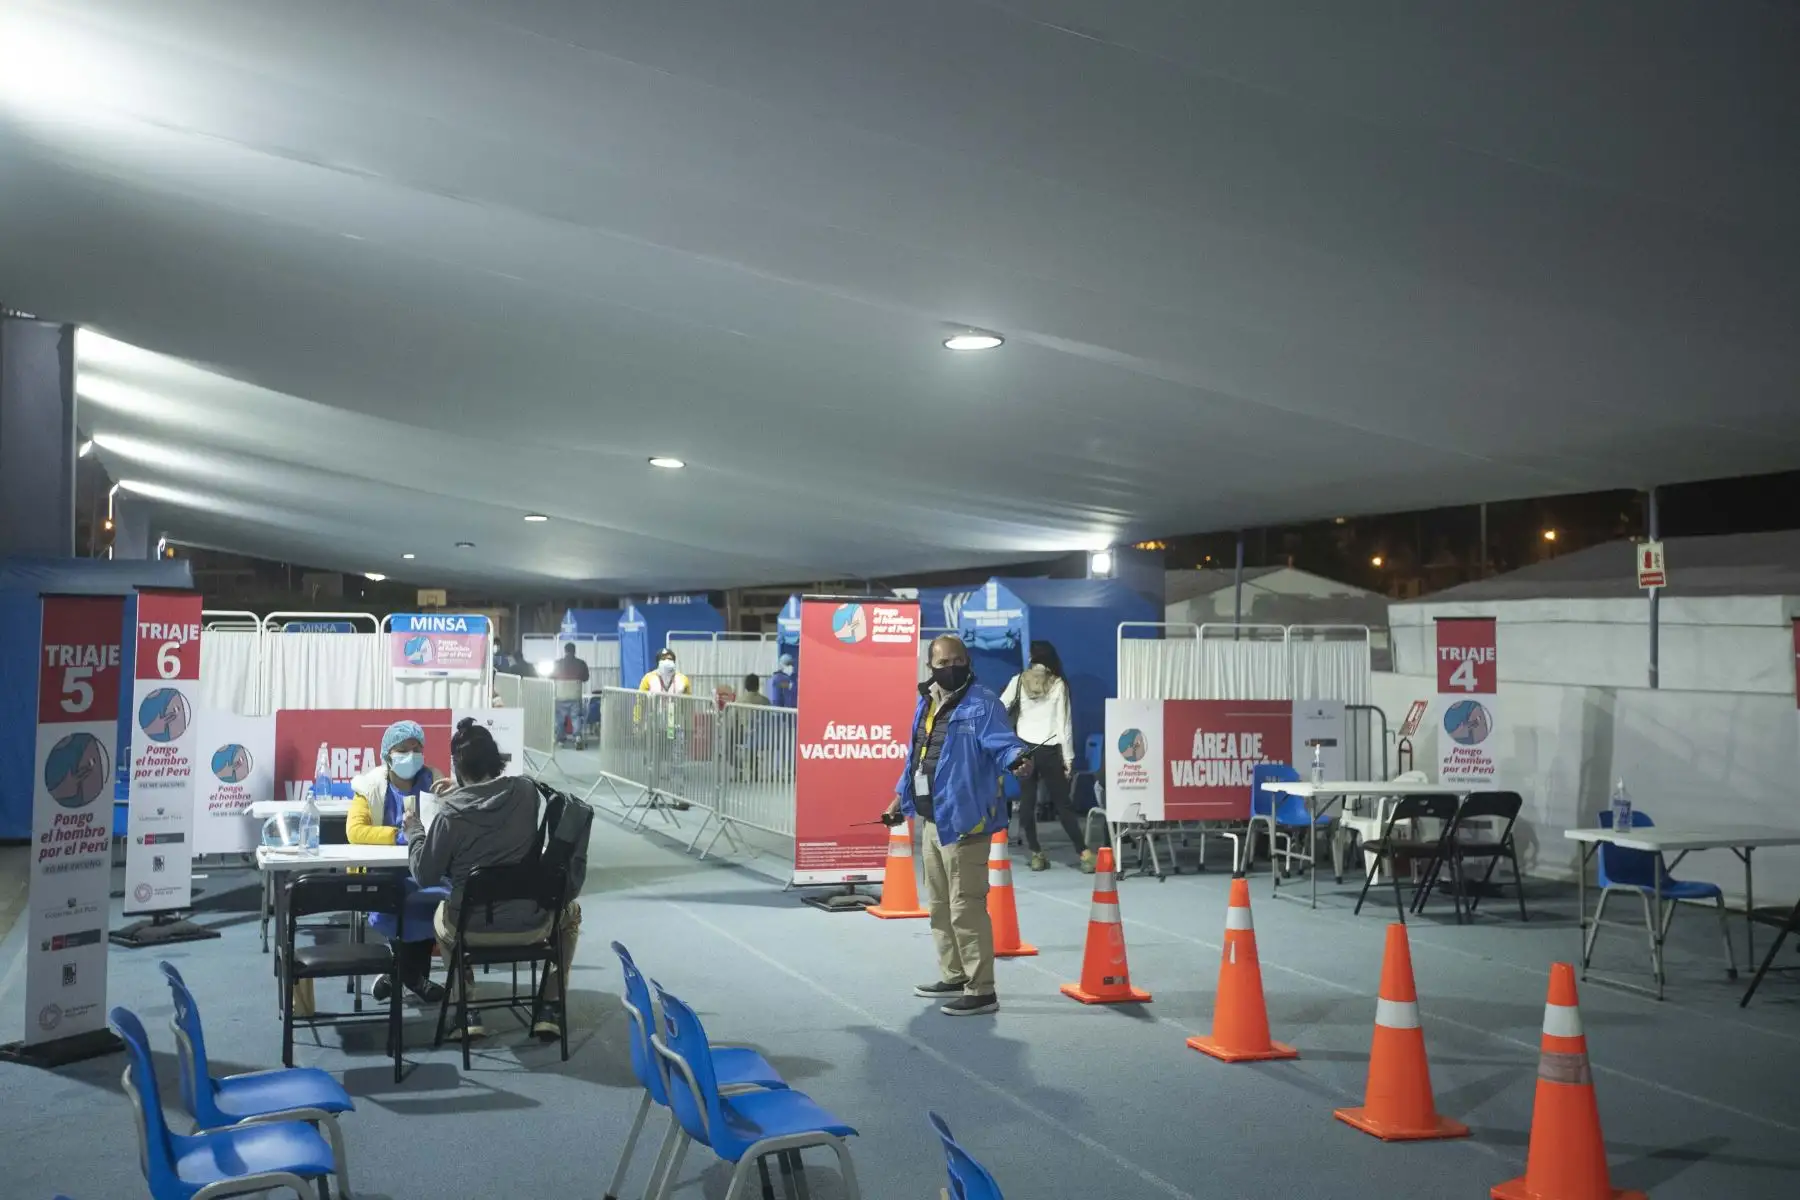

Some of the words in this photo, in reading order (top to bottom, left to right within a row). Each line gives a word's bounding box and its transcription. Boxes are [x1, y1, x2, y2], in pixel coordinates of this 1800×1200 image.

[300, 623, 337, 633] MINSA
[410, 616, 468, 632] MINSA
[139, 623, 200, 645] TRIAJE
[45, 644, 120, 672] TRIAJE
[157, 641, 181, 679] 6
[1439, 646, 1495, 665] TRIAJE
[1450, 660, 1478, 692] 4
[60, 666, 94, 713] 5
[824, 720, 869, 740] ÁREA
[870, 725, 893, 740] DE
[146, 744, 179, 757] Pongo
[1192, 728, 1239, 759] ÁREA
[1240, 733, 1264, 759] DE
[1453, 747, 1483, 757] Pongo
[136, 757, 146, 766] el
[147, 756, 189, 766] hombro
[1443, 756, 1453, 764] el
[1454, 756, 1492, 765] hombro
[134, 769, 153, 780] por
[154, 767, 165, 777] el
[166, 767, 191, 777] Perú
[1171, 755, 1284, 787] VACUNAC
[1442, 766, 1459, 775] por
[1461, 765, 1471, 773] el
[1472, 765, 1495, 774] Perú
[218, 785, 244, 794] Pongo
[219, 793, 251, 801] hombro
[208, 802, 223, 811] por
[54, 812, 94, 827] Pongo
[41, 829, 53, 843] el
[55, 824, 106, 842] hombro
[38, 845, 62, 864] por
[64, 842, 77, 856] el
[79, 837, 109, 854] Perú
